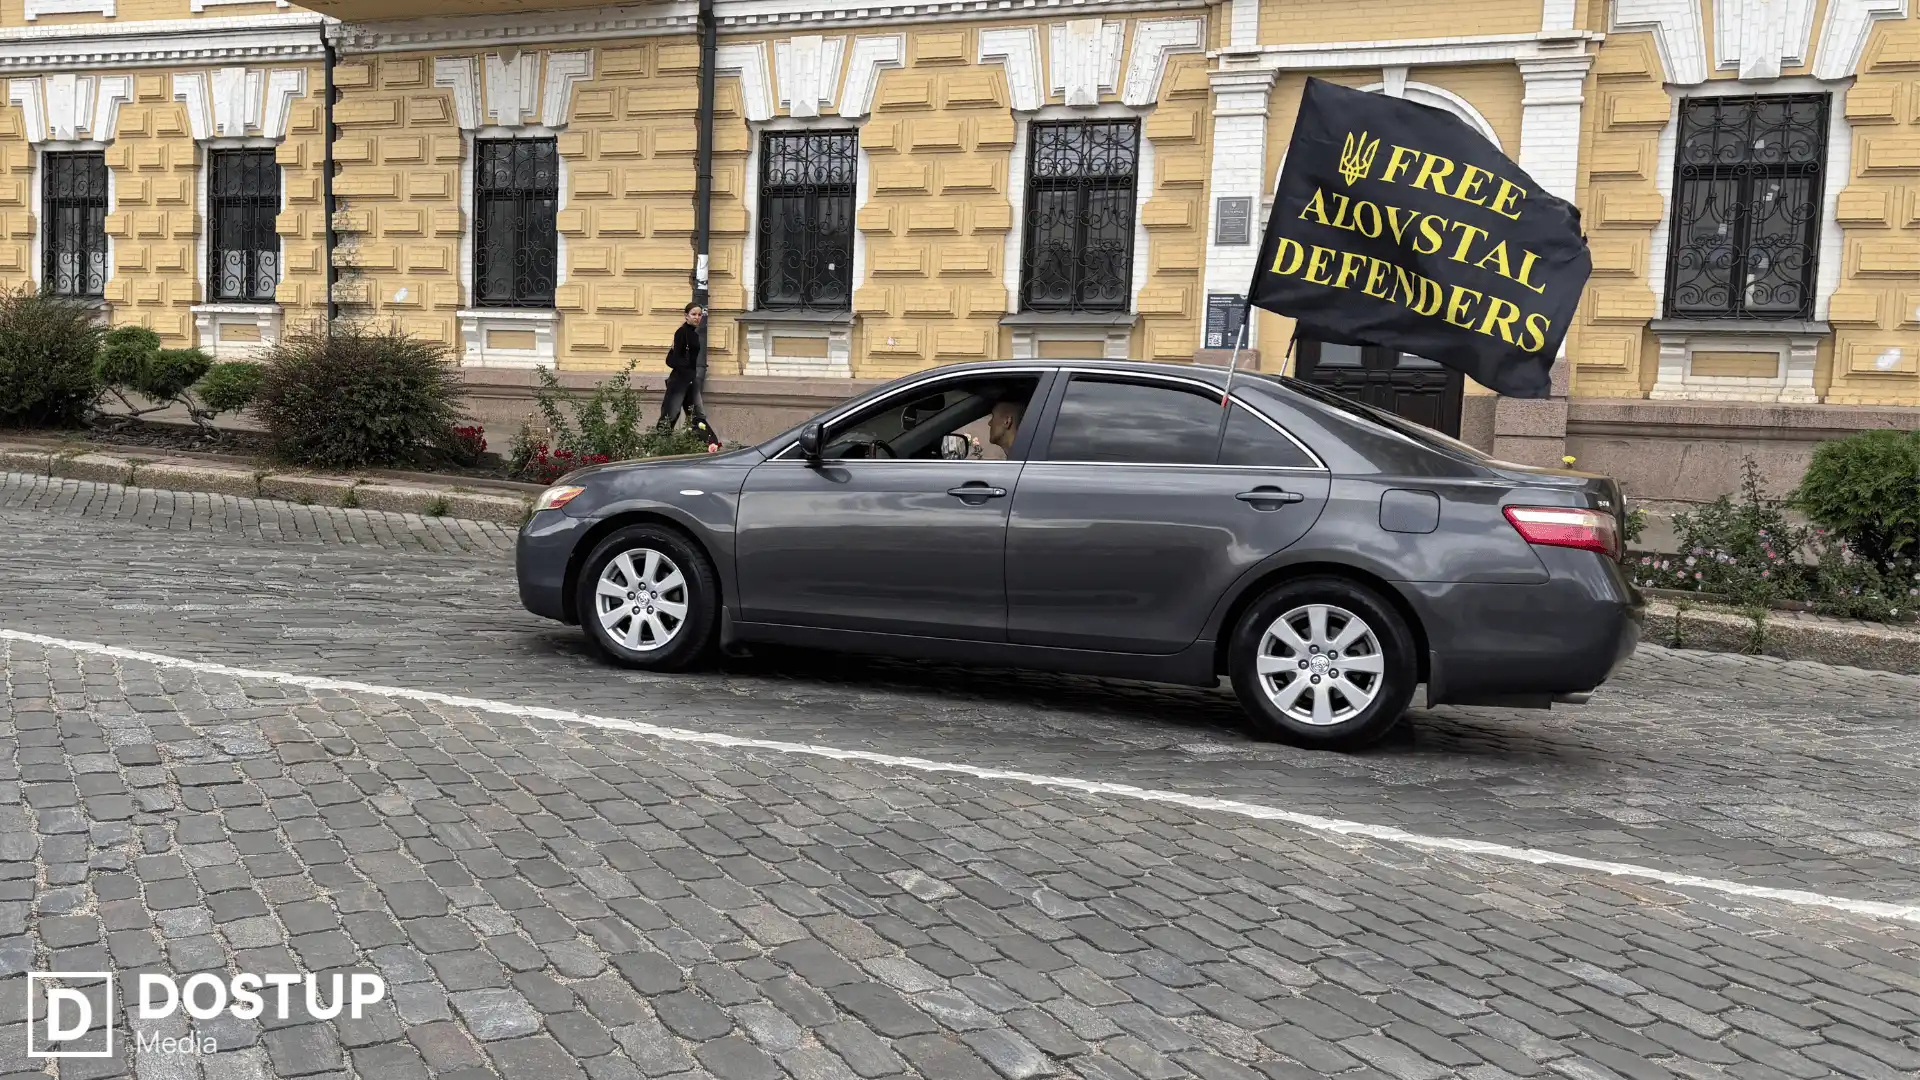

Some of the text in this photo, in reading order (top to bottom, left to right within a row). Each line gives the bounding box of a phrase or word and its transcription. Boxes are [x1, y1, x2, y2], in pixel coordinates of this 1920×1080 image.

[1378, 144, 1527, 220] FREE
[1297, 186, 1547, 294] AZOVSTAL
[1269, 236, 1552, 353] DEFENDERS
